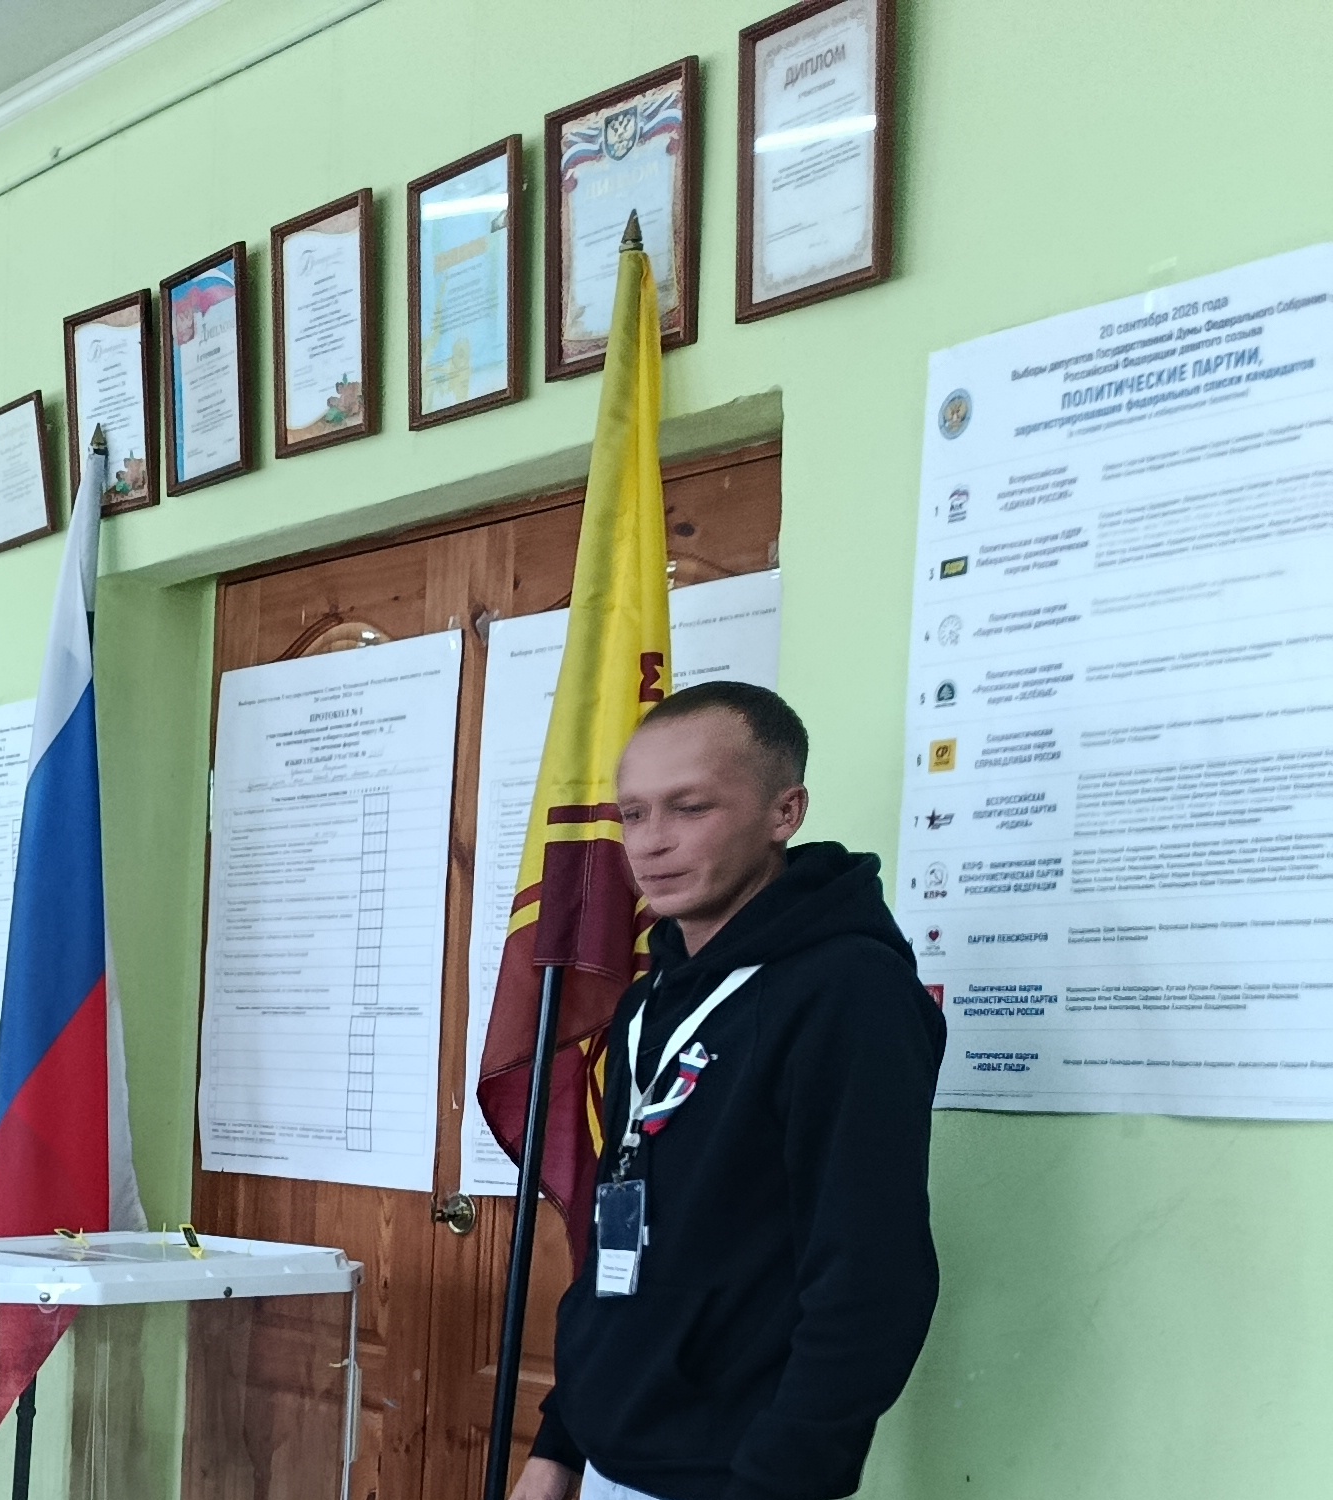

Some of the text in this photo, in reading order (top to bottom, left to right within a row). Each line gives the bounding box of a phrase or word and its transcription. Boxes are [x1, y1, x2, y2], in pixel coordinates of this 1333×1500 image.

[783, 44, 846, 90] ДИПЛОМ
[1011, 364, 1048, 382] Выборы
[1174, 325, 1203, 341] Думы
[1204, 305, 1275, 333] Федерального
[1099, 324, 1115, 340] 20
[1171, 301, 1199, 321] 2026
[1201, 296, 1229, 313] года
[1061, 345, 1264, 410] ПОЛИТИЧЕСКИЕ ПАРТИИ,
[1063, 358, 1120, 383] Российской
[1224, 325, 1264, 344] созыва
[1203, 374, 1243, 394] списки
[1245, 357, 1316, 382] кандидатов
